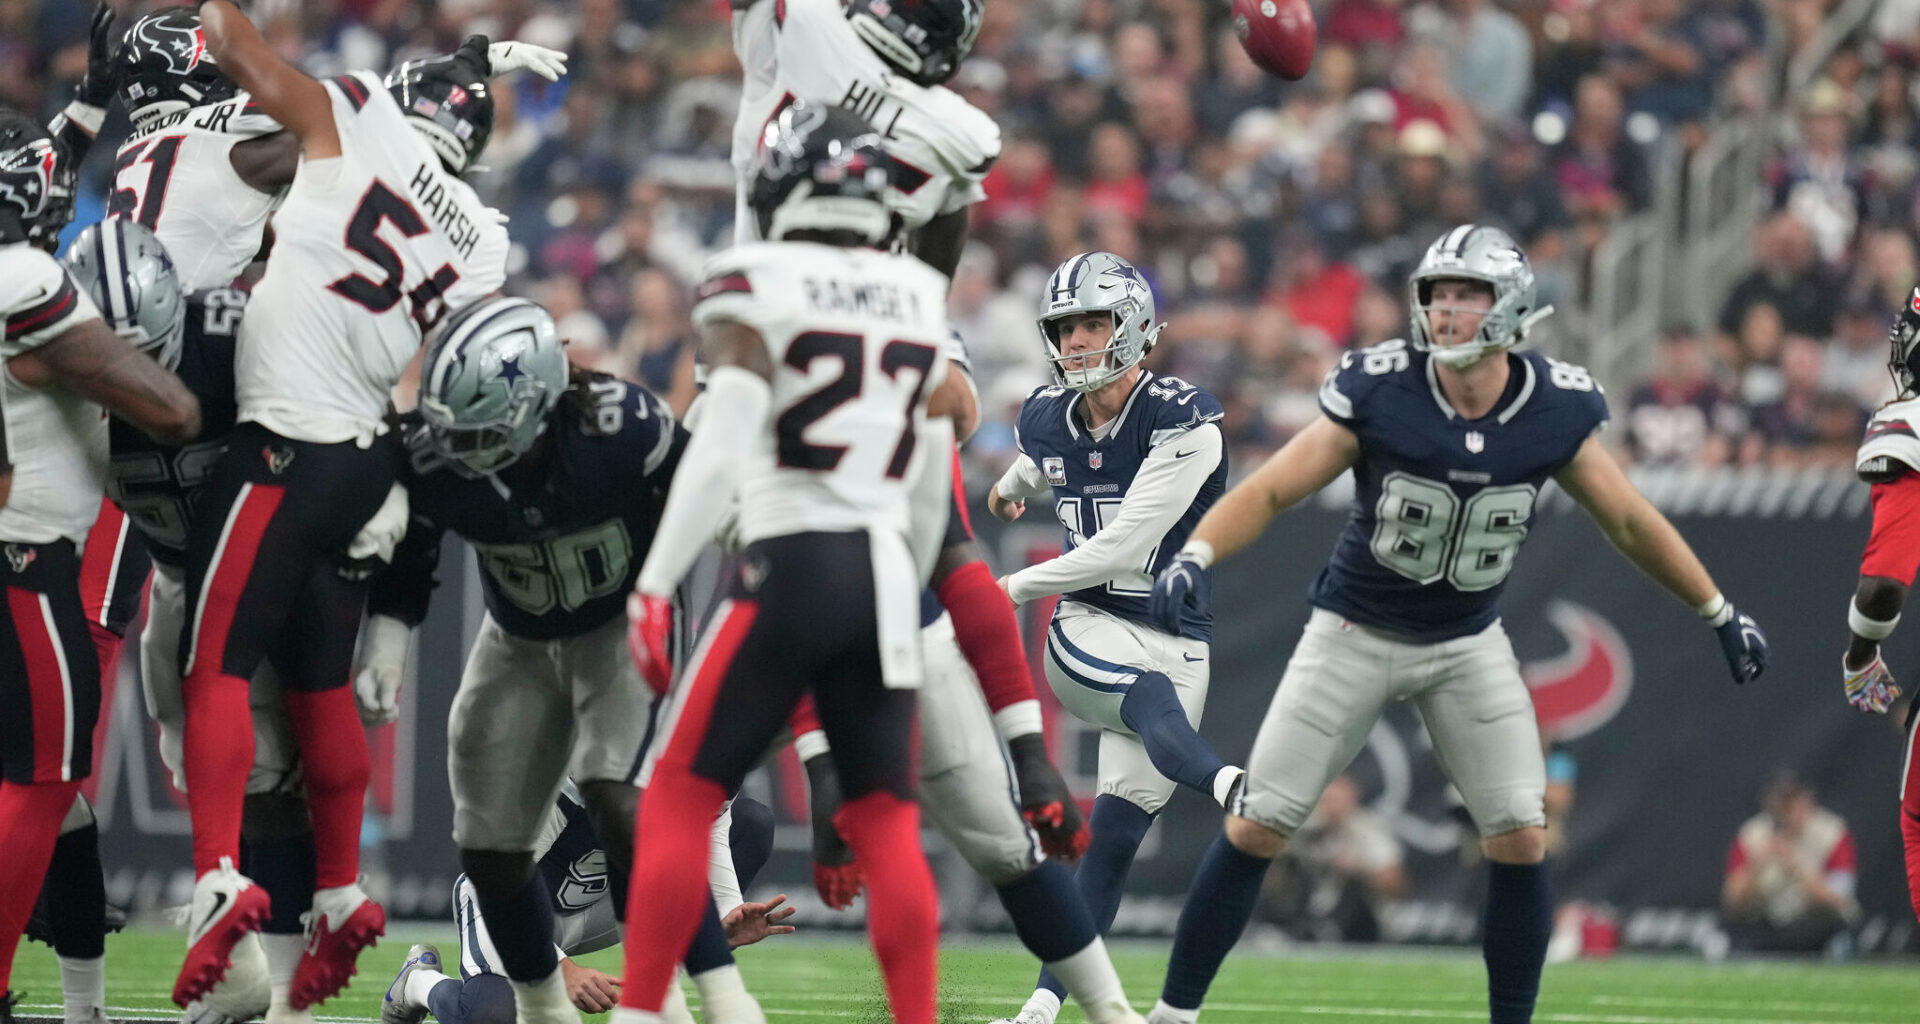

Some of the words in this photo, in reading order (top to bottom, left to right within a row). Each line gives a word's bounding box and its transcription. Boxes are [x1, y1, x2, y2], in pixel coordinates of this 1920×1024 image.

[194, 103, 237, 133] JR
[840, 80, 904, 141] HILL
[410, 163, 480, 261] HARSH
[776, 330, 936, 479] 27
[1148, 376, 1197, 401] 17
[1544, 356, 1593, 392] 8
[1370, 471, 1537, 592] 86
